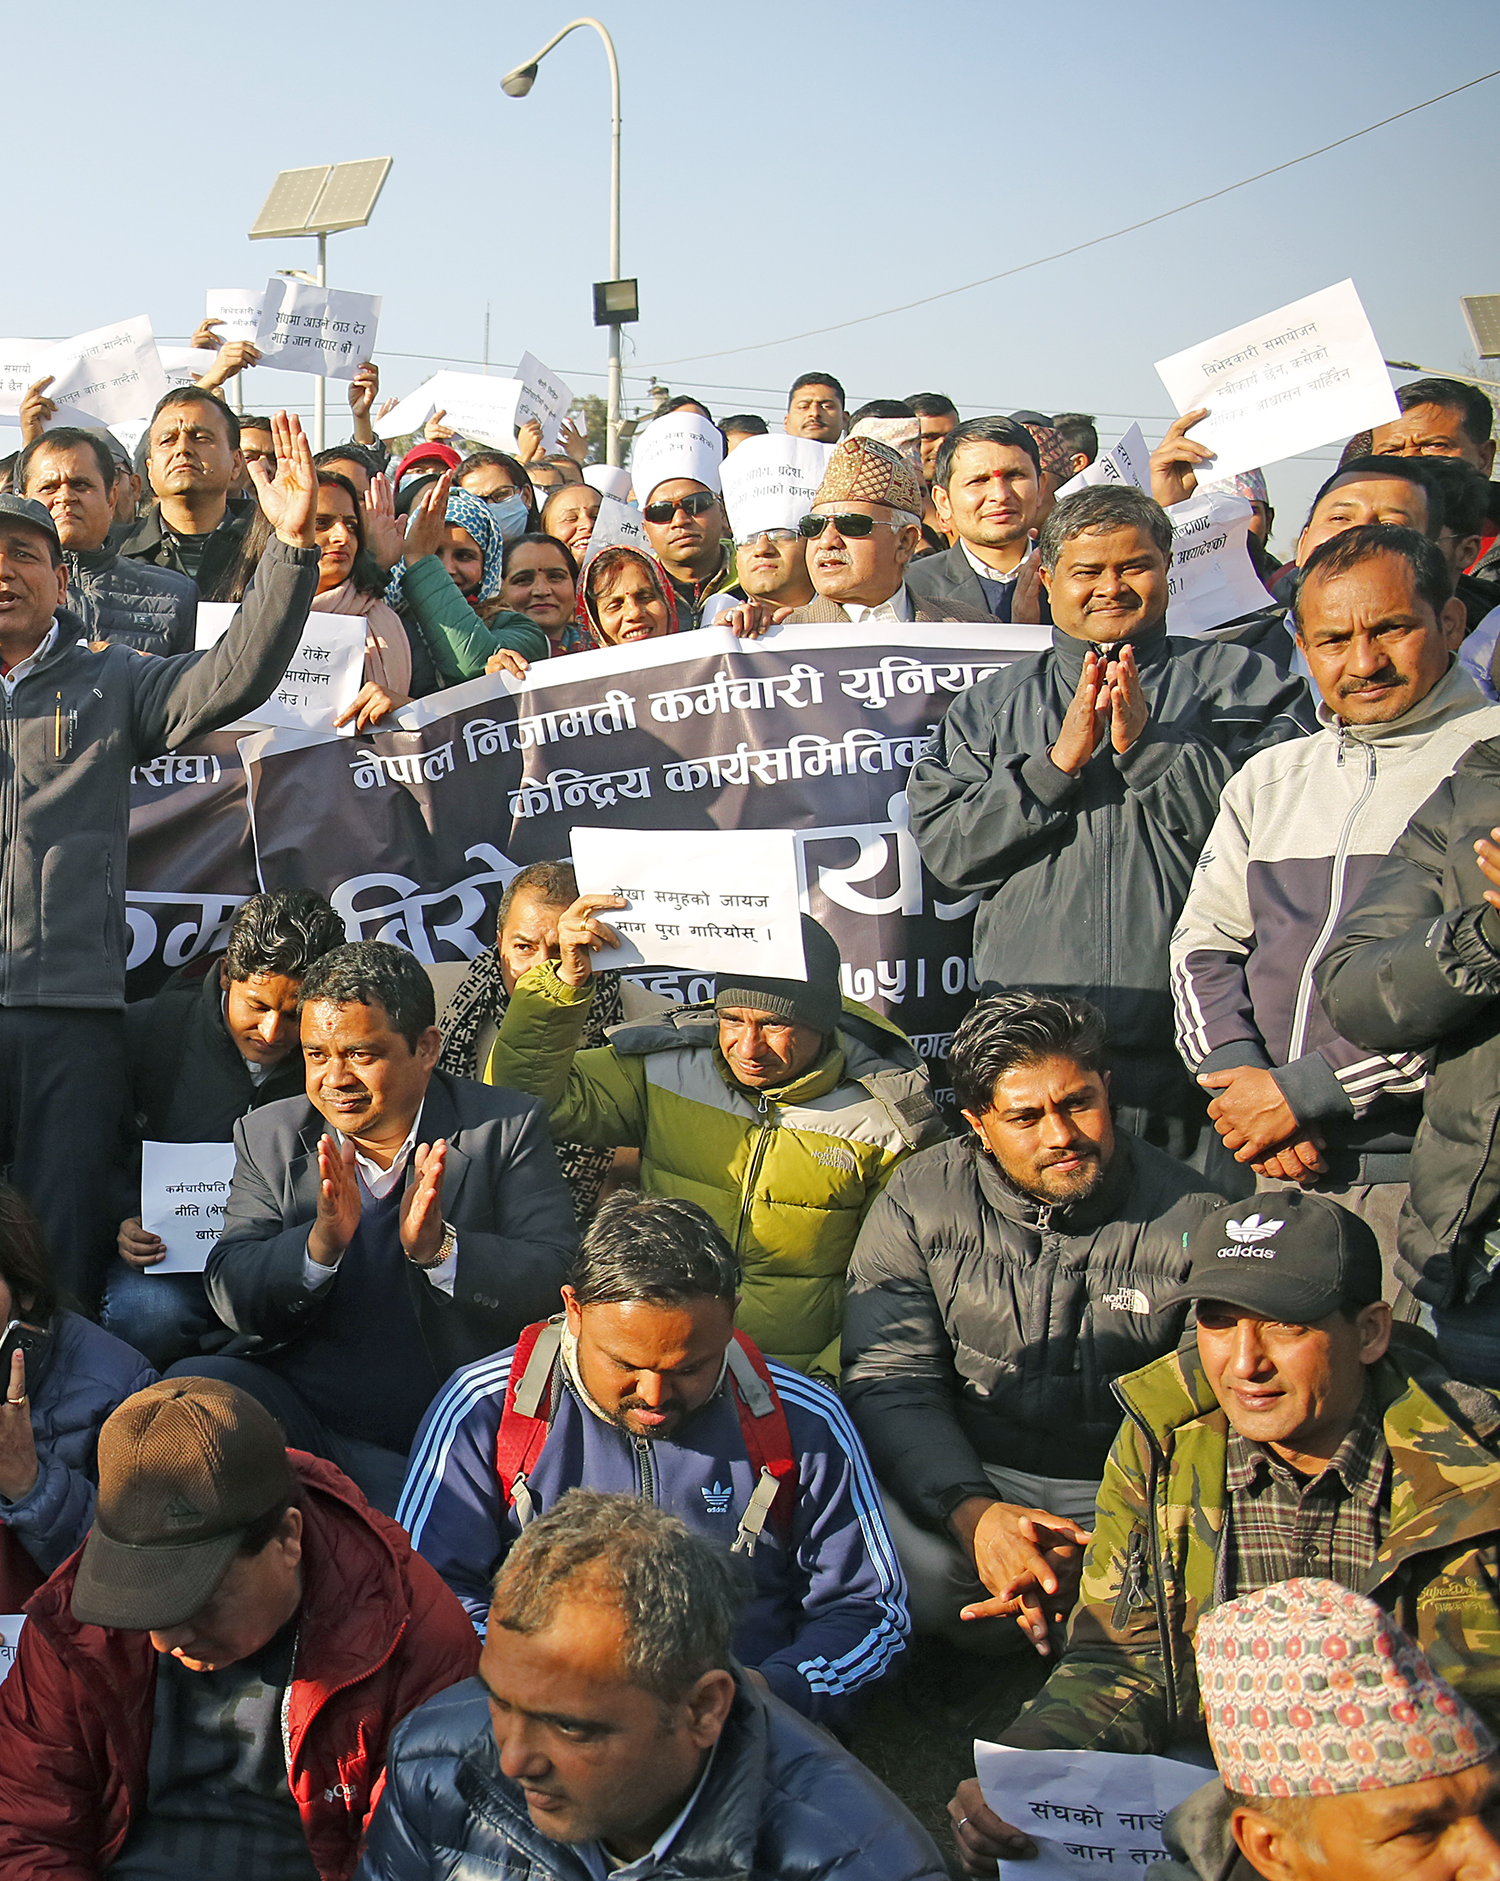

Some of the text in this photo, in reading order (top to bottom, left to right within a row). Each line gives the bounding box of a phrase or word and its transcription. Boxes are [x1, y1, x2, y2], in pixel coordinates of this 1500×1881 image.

[276, 311, 301, 326] संघमा
[304, 316, 329, 330] आउने
[332, 320, 350, 333] ठाउ
[353, 321, 366, 335] देउ
[292, 335, 312, 347] जान
[314, 337, 338, 351] तयार
[1202, 322, 1318, 378] विभेदकारी समायोजन
[1216, 370, 1259, 399] स्वीकार्य
[1289, 345, 1329, 370] कसैको
[8, 379, 24, 391] छैन
[302, 644, 331, 662] रोकेर
[284, 667, 331, 686] मायोजन
[277, 689, 299, 706] लेउ
[349, 740, 455, 790] नेपाल
[462, 688, 637, 764] निजामती
[647, 662, 825, 724] कर्मचारी
[507, 767, 652, 819] केन्द्रिय
[610, 885, 770, 912] लेखा समुहको जायज
[615, 920, 759, 944] माग पुरा गारियोस्
[165, 1181, 226, 1193] कर्मचारीप्रति
[175, 1203, 200, 1217] नीति
[1216, 1244, 1276, 1260] adidas
[1101, 1293, 1135, 1304] NORTH
[1117, 1287, 1136, 1296] THE
[1110, 1301, 1135, 1311] FACE
[1027, 1800, 1105, 1829] संघको
[1062, 1841, 1116, 1864] जान
